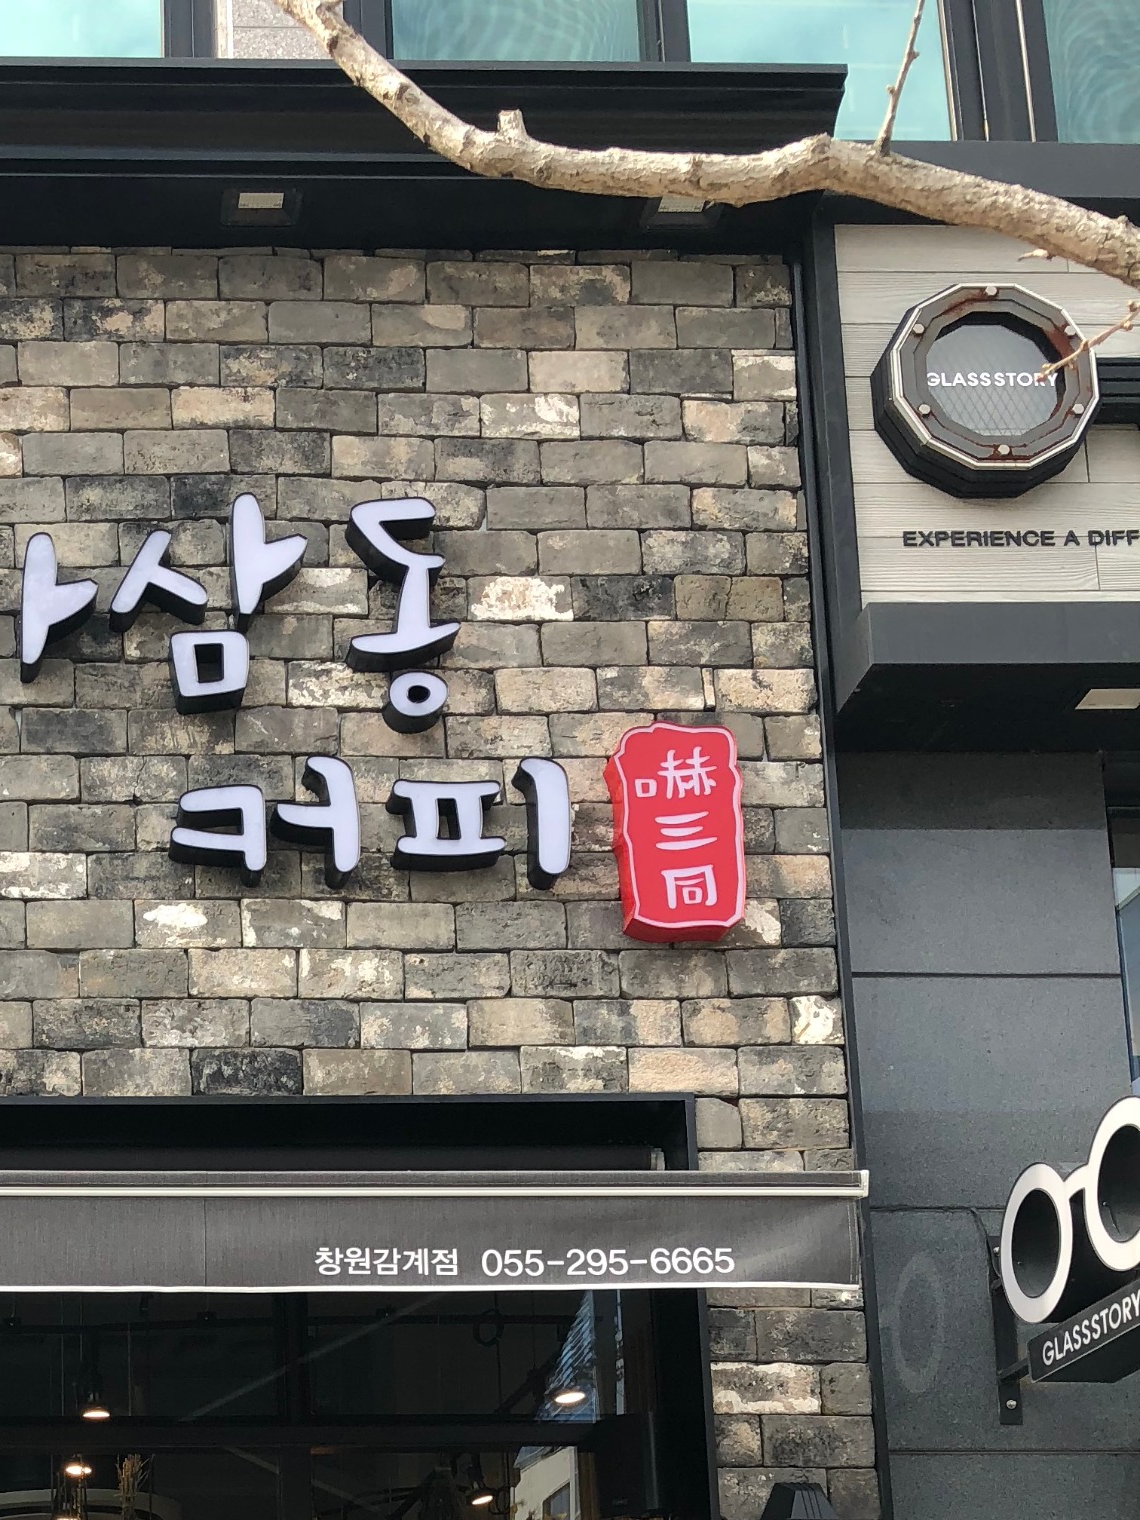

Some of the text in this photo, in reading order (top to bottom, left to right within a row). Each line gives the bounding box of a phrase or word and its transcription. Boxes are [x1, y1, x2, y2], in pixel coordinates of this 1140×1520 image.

[903, 530, 1140, 547] EXPERIENCE A DIFF
[169, 755, 571, 889] 커피
[314, 1247, 735, 1277] 창원감계점 055-295-6665
